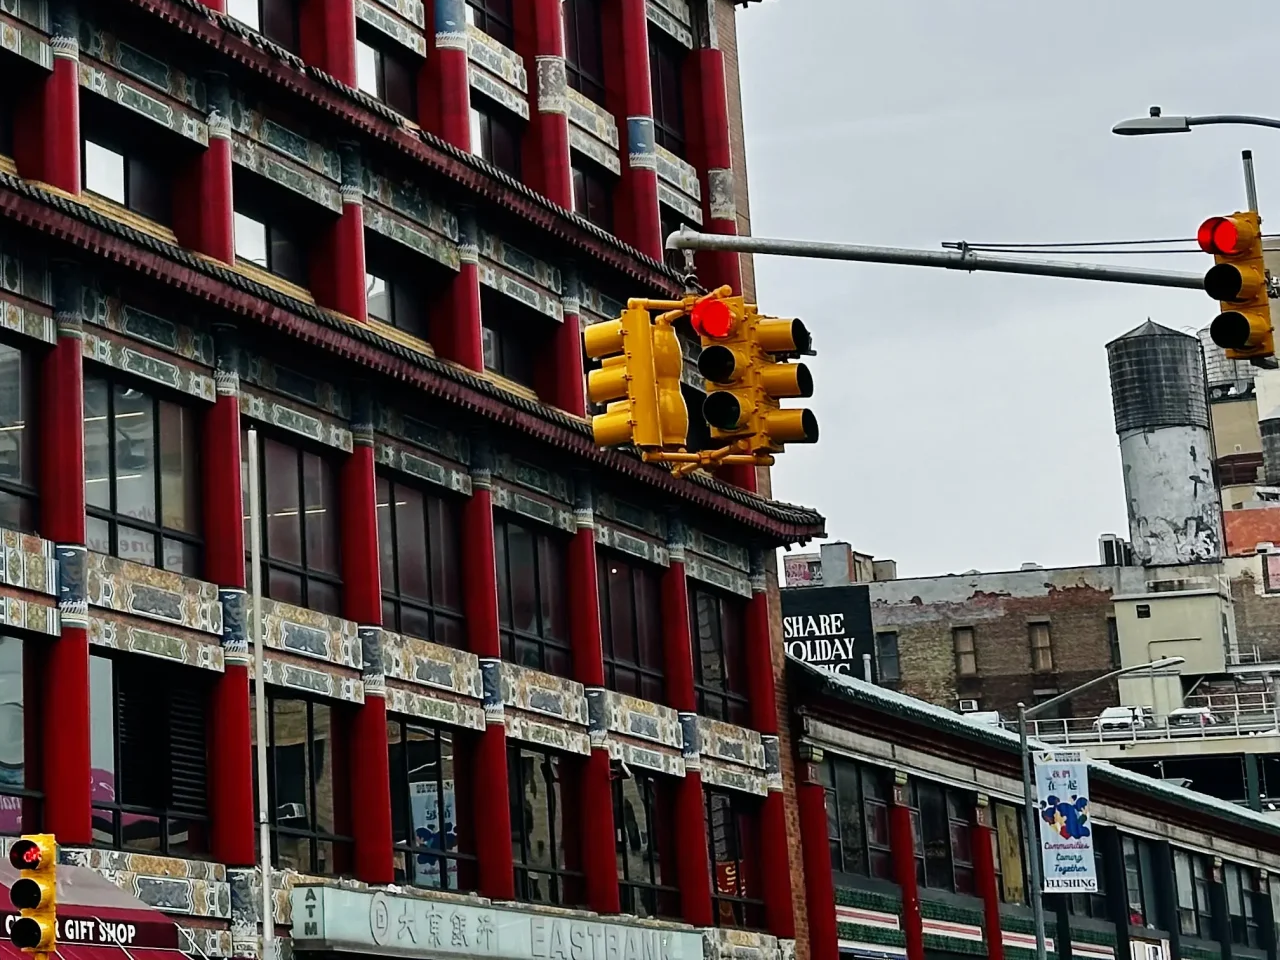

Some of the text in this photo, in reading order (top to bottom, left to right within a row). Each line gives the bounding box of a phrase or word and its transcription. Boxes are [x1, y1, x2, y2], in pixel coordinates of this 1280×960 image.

[783, 613, 846, 638] SHARE
[1054, 864, 1088, 875] Together
[1046, 879, 1096, 888] FLUSHING
[305, 888, 318, 936] ATM
[64, 919, 95, 940] GIFT
[98, 922, 136, 944] SHOP
[530, 917, 674, 960] EASTBANK
